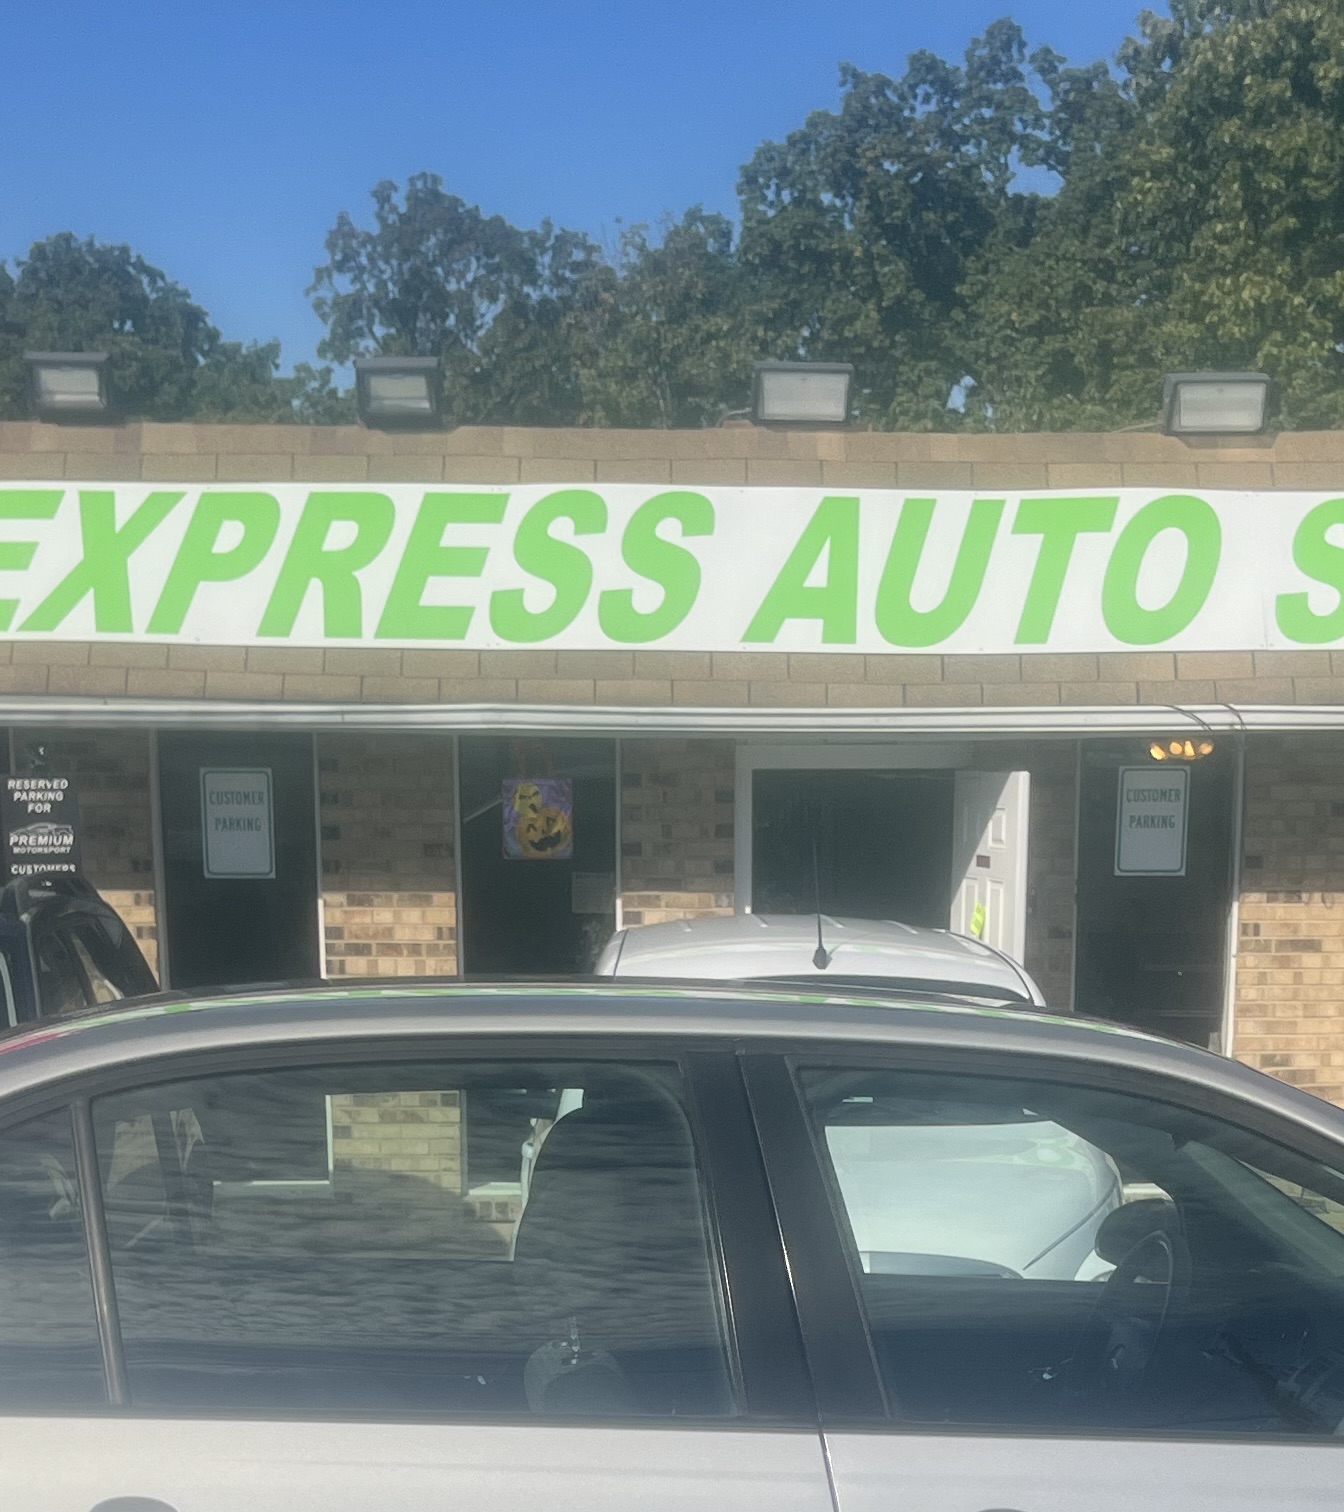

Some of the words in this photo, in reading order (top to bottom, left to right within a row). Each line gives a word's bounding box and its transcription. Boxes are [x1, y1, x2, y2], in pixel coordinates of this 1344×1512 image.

[750, 498, 1218, 644] AUTO
[7, 778, 69, 790] RESERVED
[13, 790, 64, 802] PARKING
[209, 791, 265, 805] CUSTOMER
[1126, 788, 1182, 803] CUSTOMER
[27, 802, 52, 814] FOR
[214, 817, 262, 832] PARKING
[1129, 815, 1176, 829] PARKING
[9, 834, 74, 846] PREMIUM
[13, 846, 71, 854] MOTORSPORT
